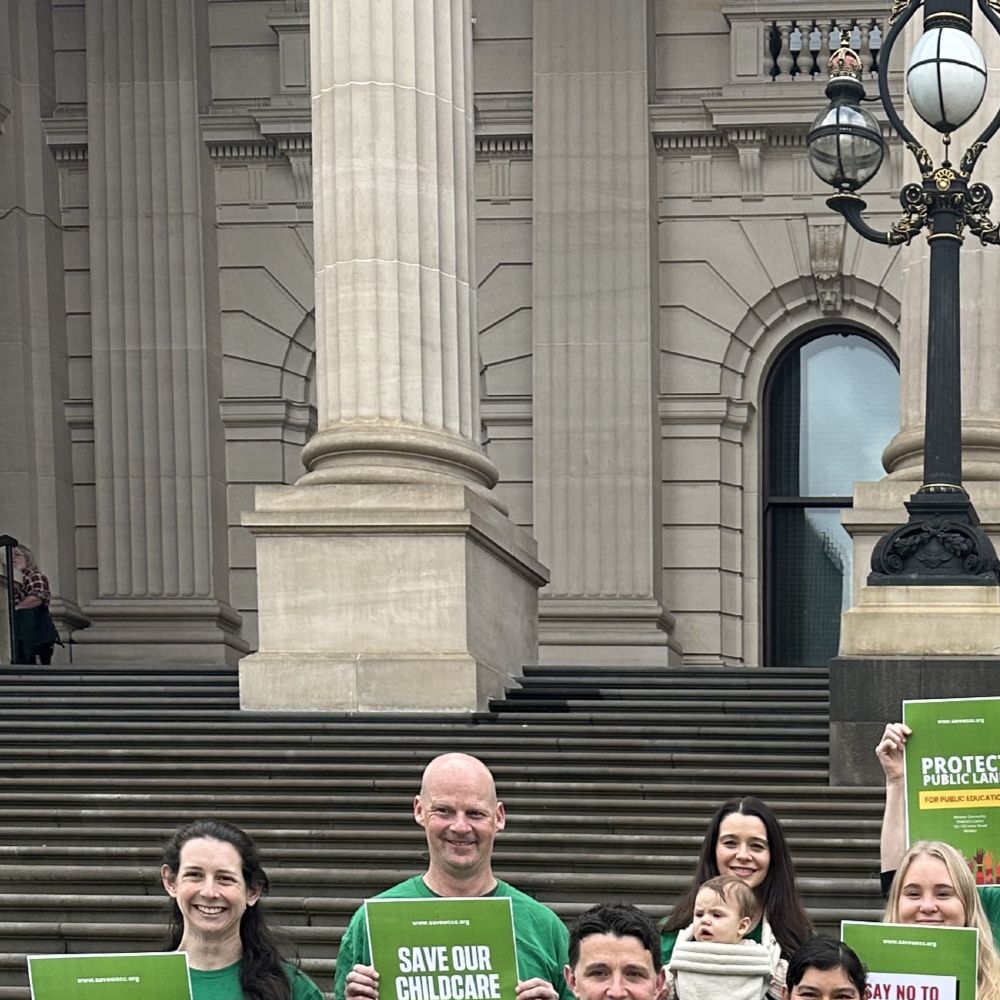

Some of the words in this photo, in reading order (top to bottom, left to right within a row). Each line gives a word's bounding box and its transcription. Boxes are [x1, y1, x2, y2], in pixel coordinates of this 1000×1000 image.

[923, 773, 969, 786] PUBLIC
[925, 796, 939, 804] FOR
[940, 795, 964, 803] PUBLIC
[398, 946, 449, 973] SAVE
[452, 946, 492, 971] OUR
[396, 974, 501, 1000] CHILDCARE
[865, 983, 891, 1000] SAY
[896, 985, 915, 1000] NO
